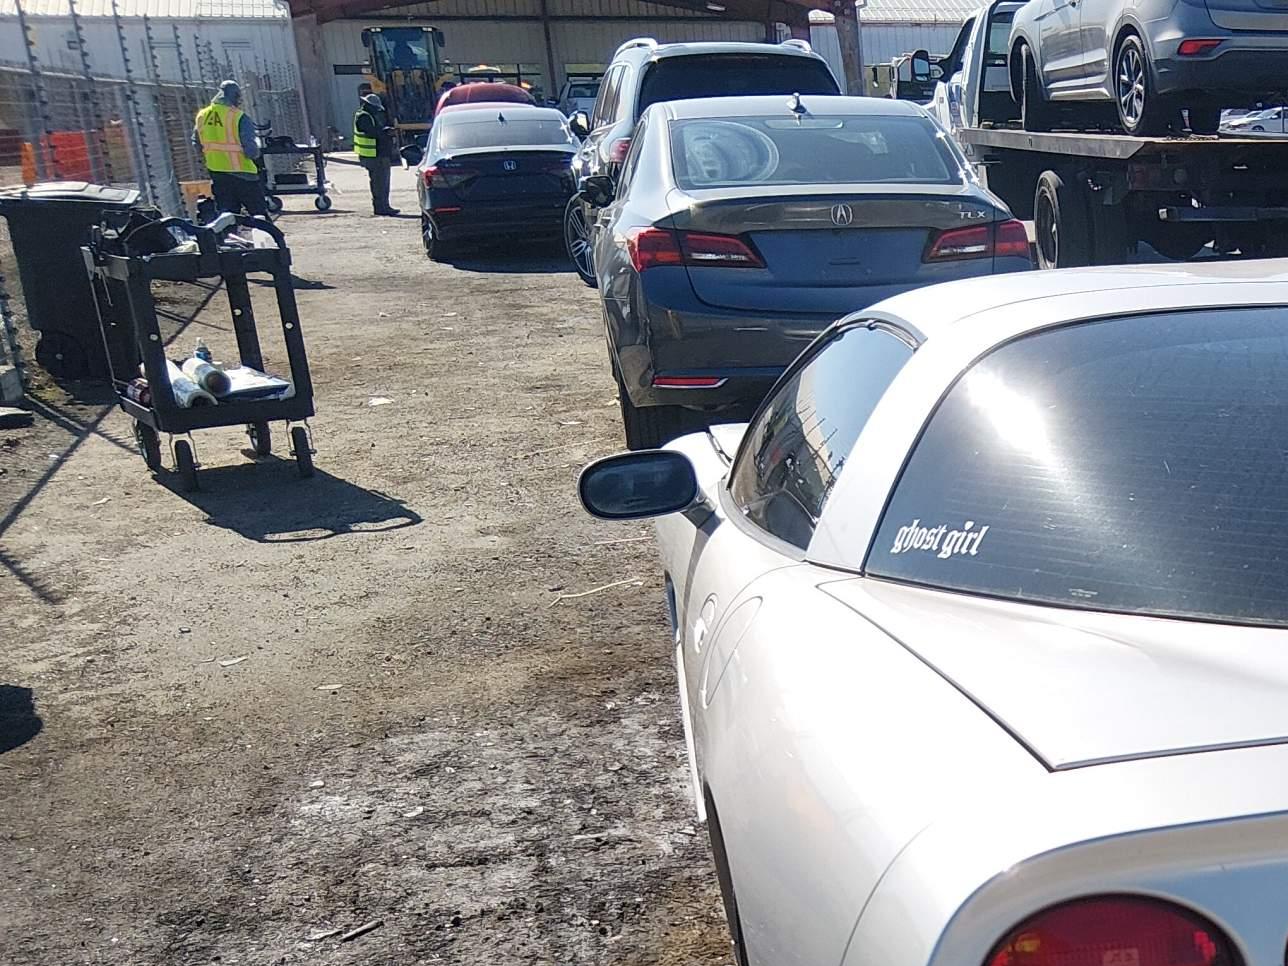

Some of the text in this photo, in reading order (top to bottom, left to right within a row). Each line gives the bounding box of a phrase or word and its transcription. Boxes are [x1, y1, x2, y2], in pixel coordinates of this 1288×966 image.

[960, 210, 986, 219] TLX
[890, 518, 990, 559] ghost girl
